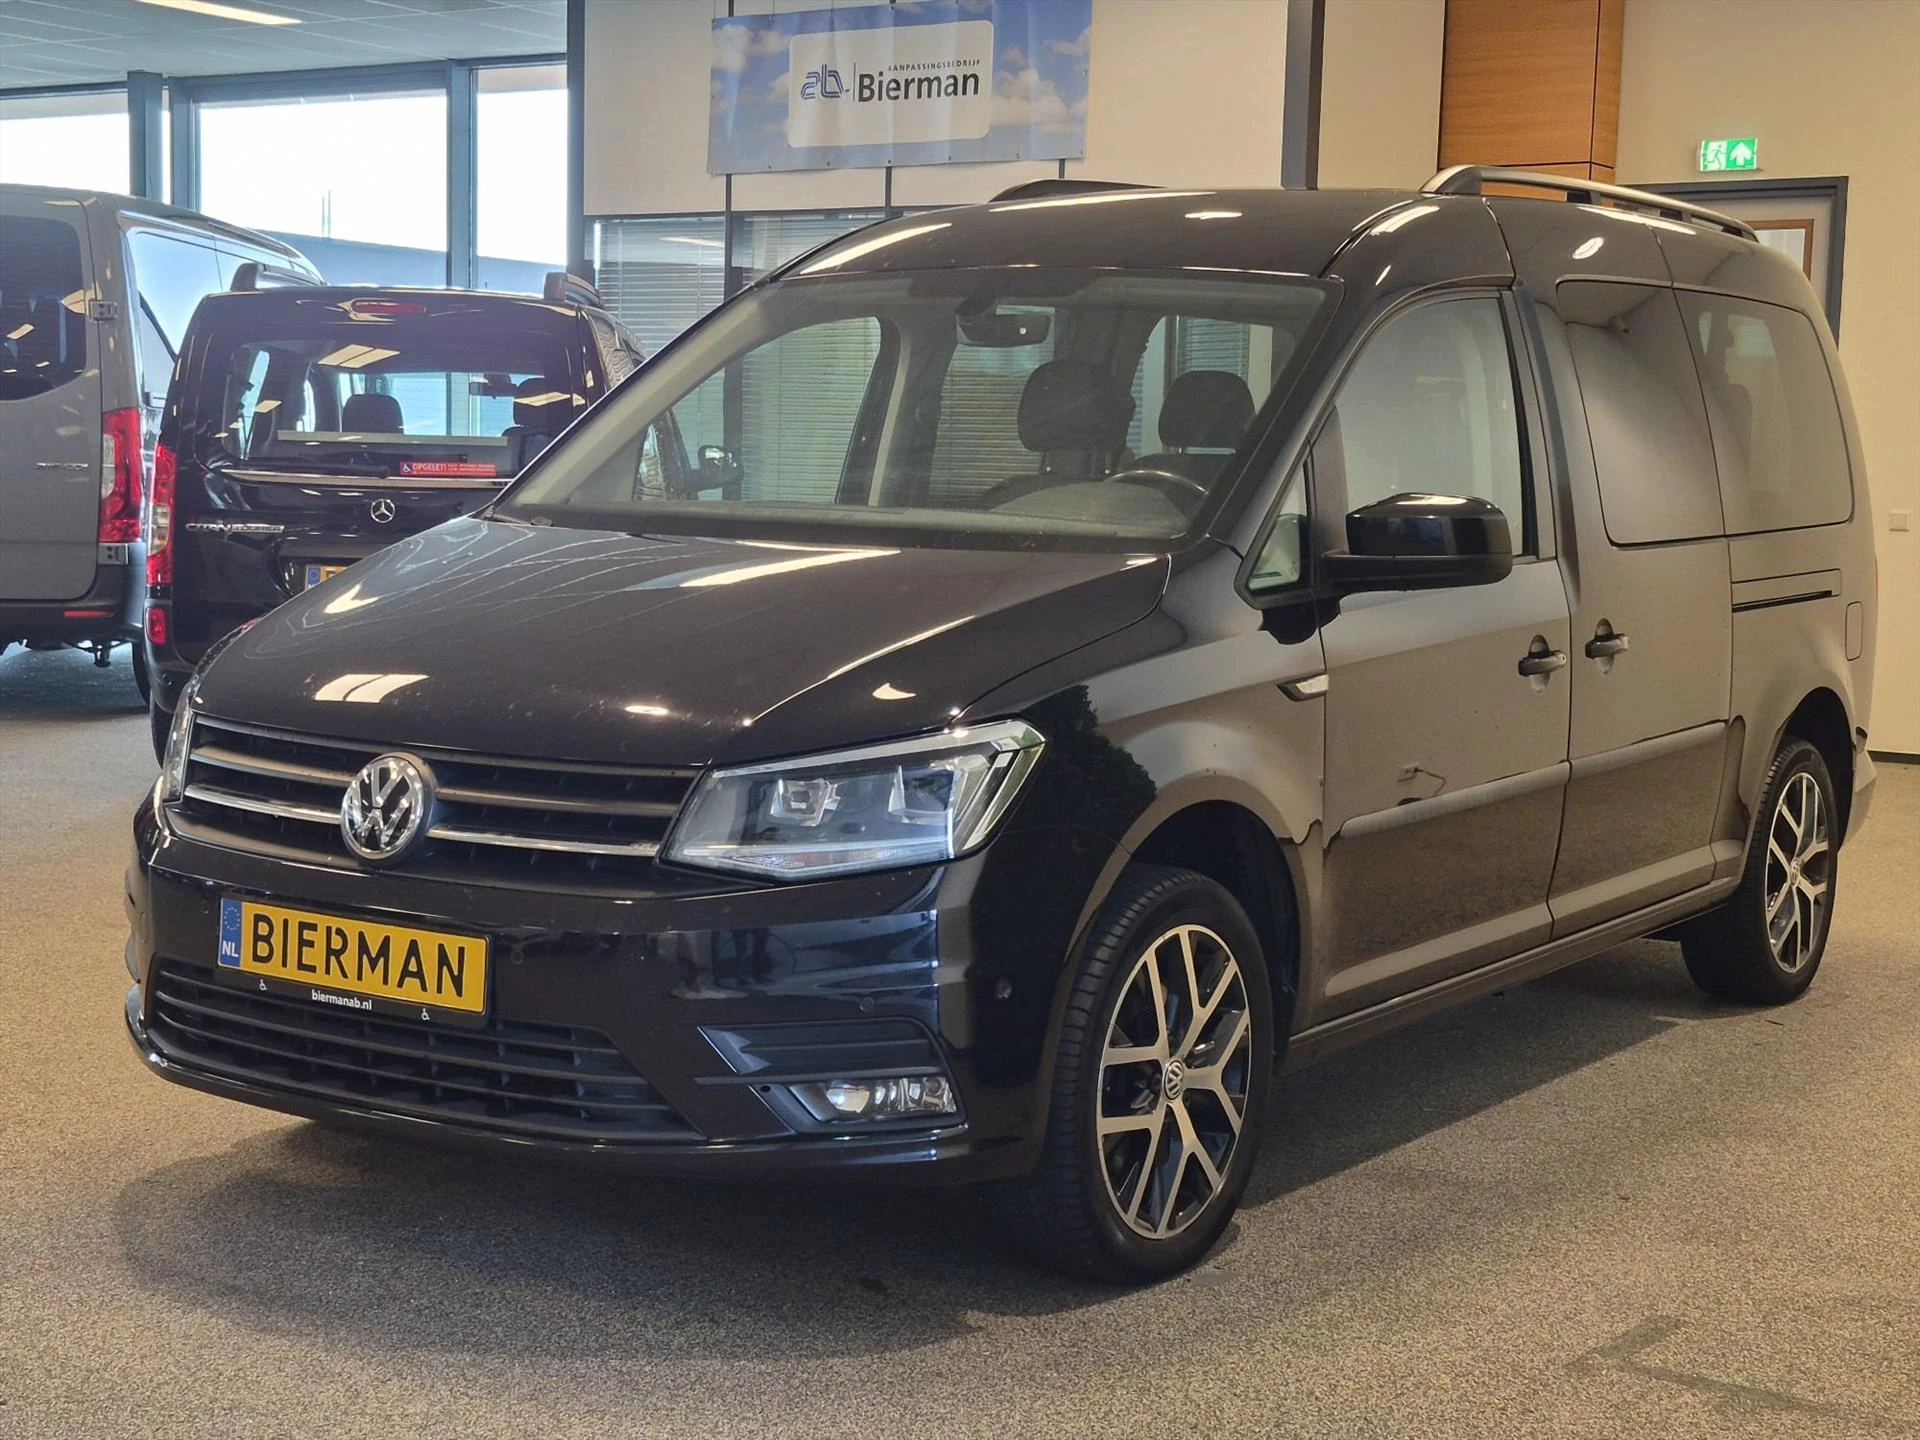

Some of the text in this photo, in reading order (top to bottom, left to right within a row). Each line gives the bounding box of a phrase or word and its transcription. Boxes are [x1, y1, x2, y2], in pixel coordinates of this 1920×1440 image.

[858, 71, 979, 103] Bierman
[222, 940, 240, 958] NL
[251, 912, 466, 998] BIERMAN
[311, 988, 373, 1011] biermanab.nl
